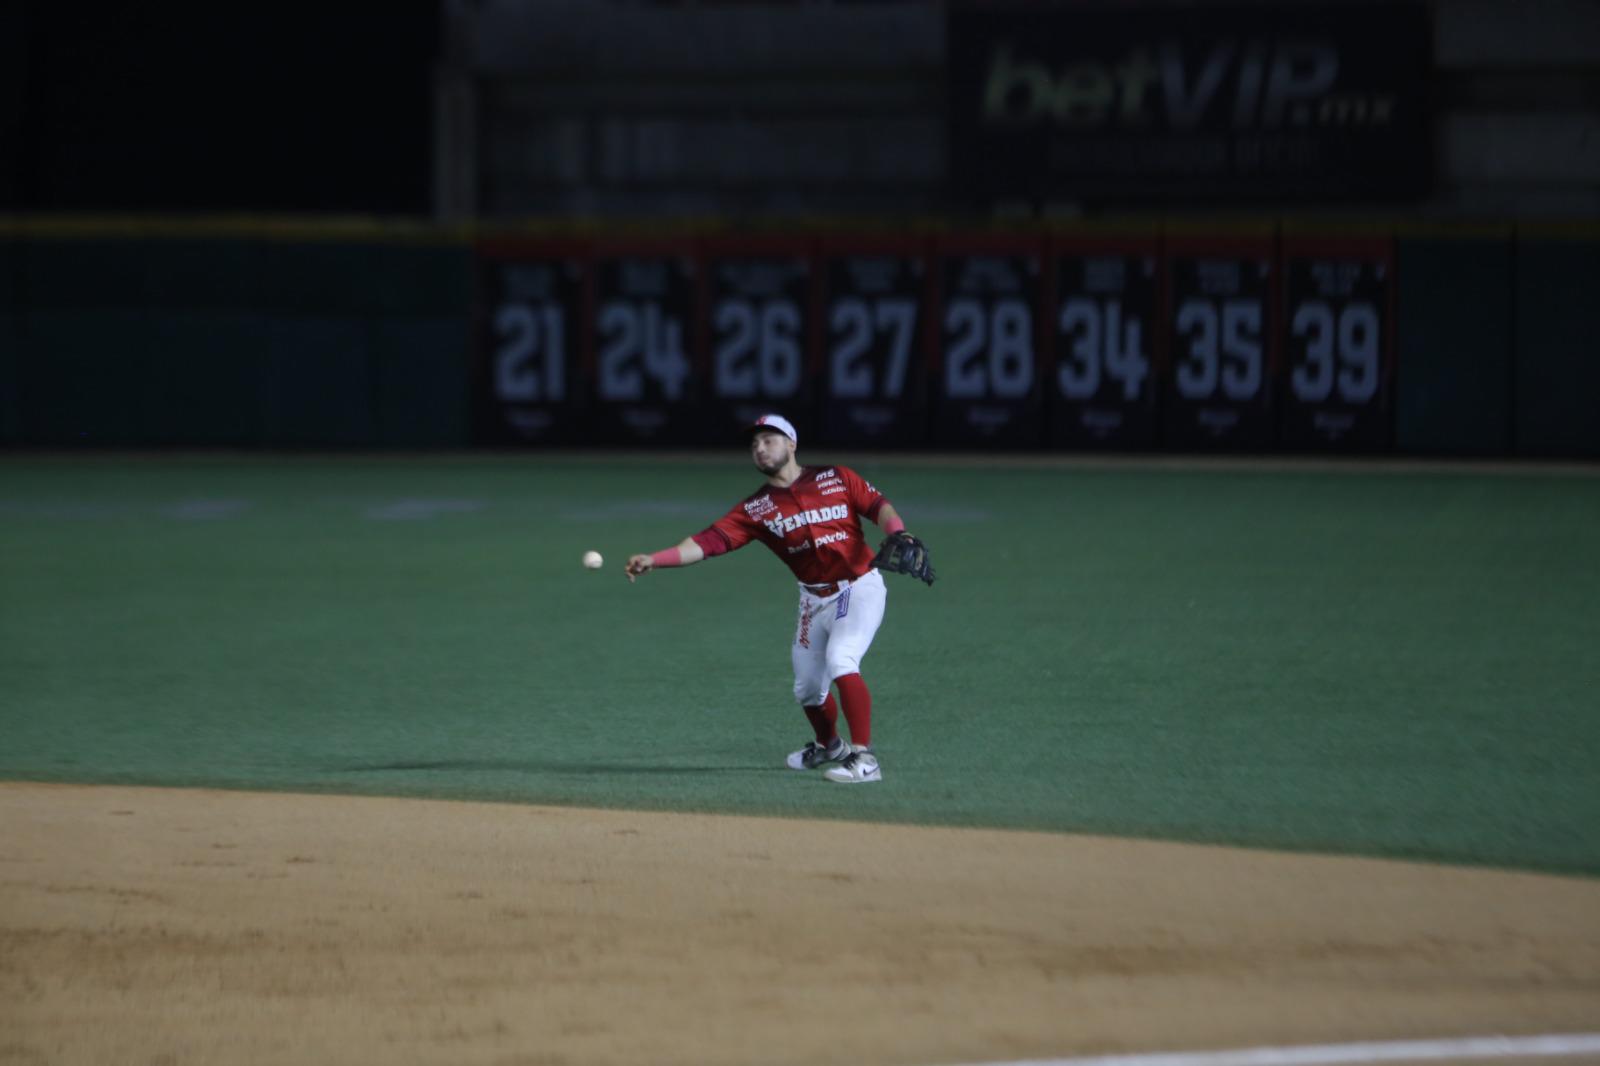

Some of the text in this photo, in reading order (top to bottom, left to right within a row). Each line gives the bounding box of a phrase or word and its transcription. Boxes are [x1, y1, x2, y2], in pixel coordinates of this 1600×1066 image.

[493, 303, 566, 402] 21
[597, 299, 690, 402] 24
[713, 298, 803, 399] 26
[829, 297, 918, 399] 27
[944, 297, 1035, 400] 28
[1058, 297, 1150, 402] 34
[1175, 297, 1263, 401] 35
[1290, 300, 1380, 403] 39
